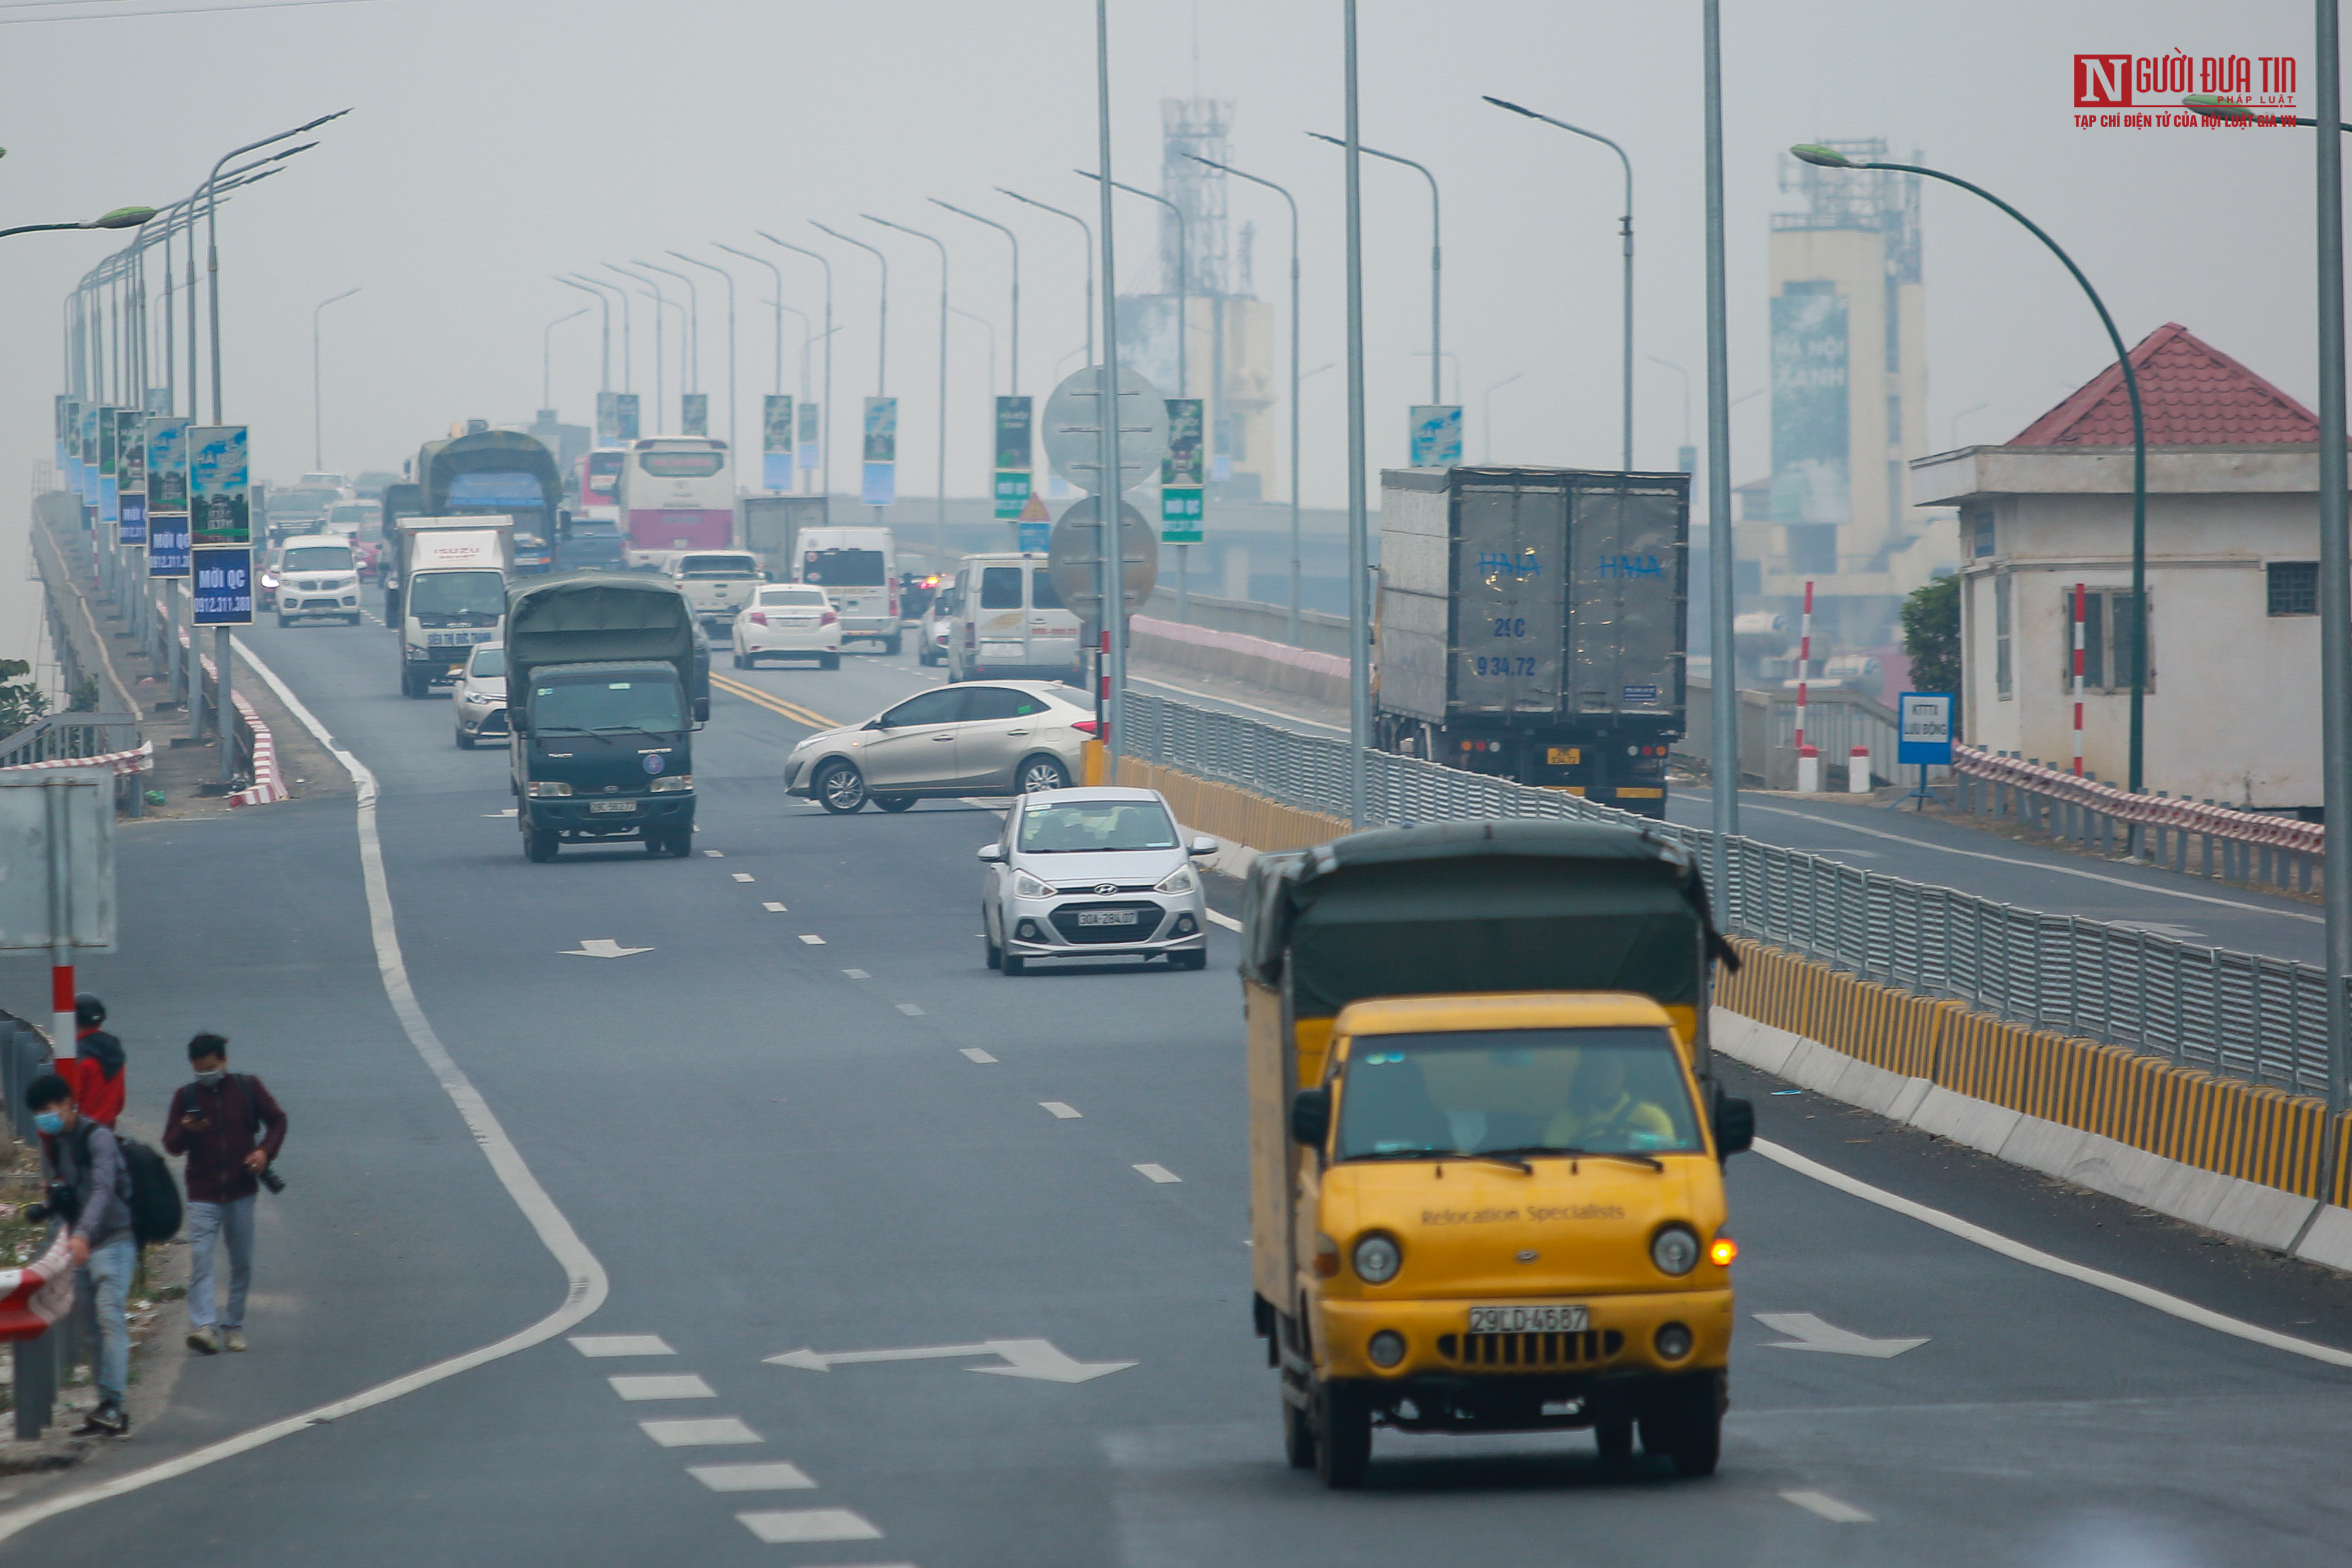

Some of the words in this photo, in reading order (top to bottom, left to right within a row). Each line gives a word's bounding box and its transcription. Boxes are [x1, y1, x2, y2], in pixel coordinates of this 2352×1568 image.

[199, 566, 224, 589] MỜI
[227, 569, 245, 590] QC
[1421, 1209, 1520, 1226] Relocation
[1527, 1205, 1626, 1223] Specialists
